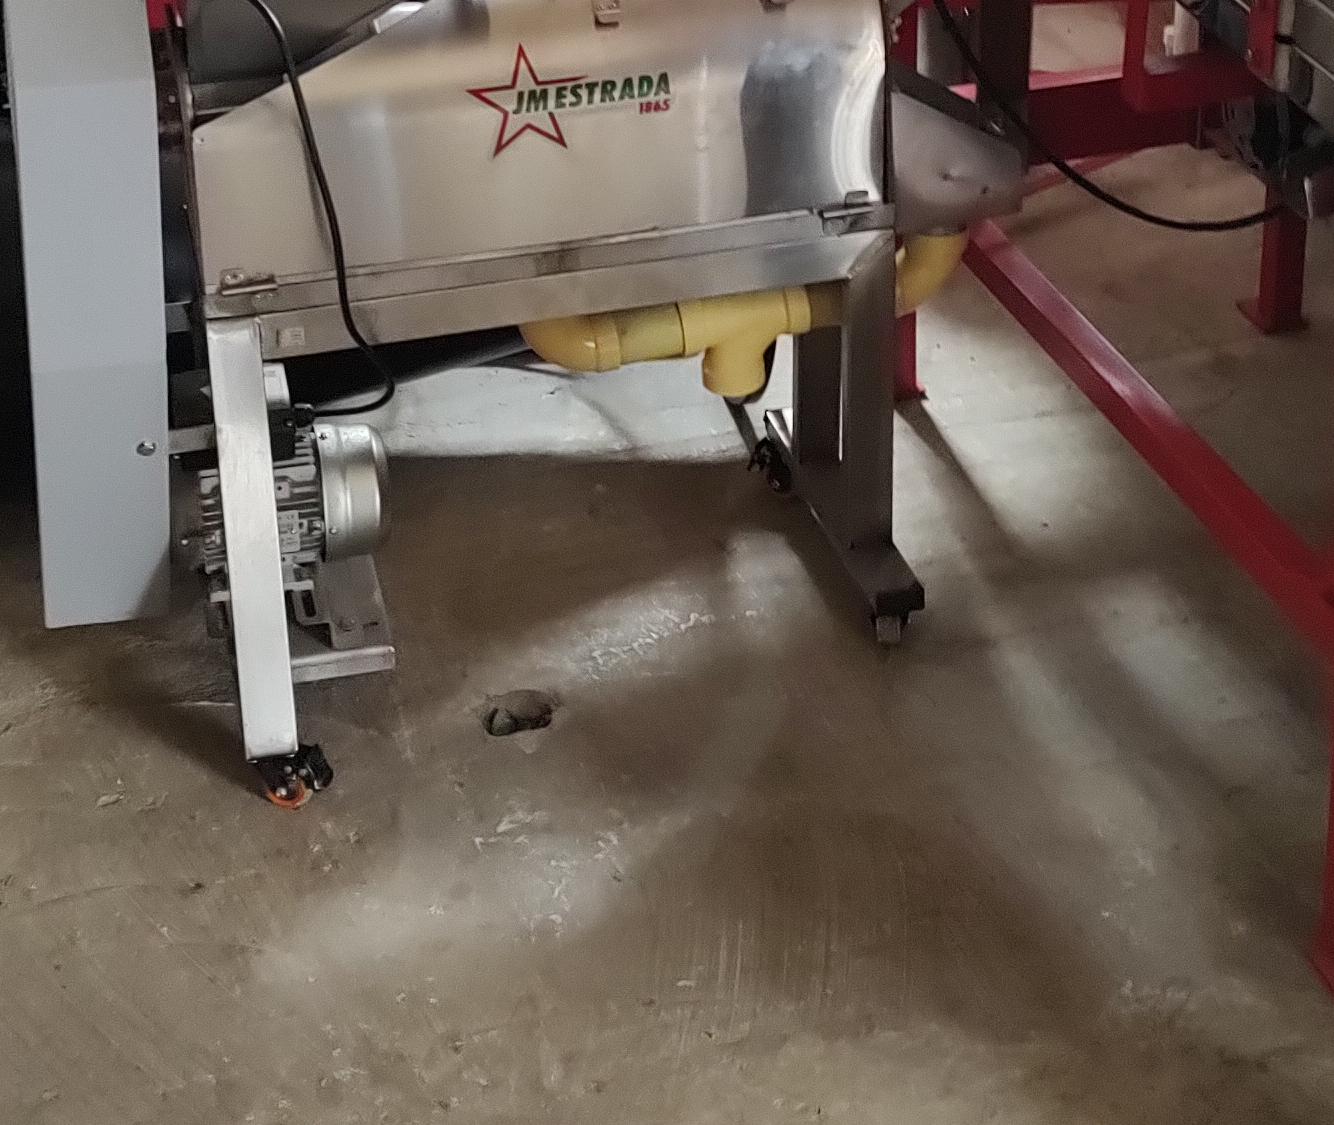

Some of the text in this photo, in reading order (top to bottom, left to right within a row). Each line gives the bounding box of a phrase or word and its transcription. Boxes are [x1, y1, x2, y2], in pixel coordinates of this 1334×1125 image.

[513, 72, 671, 115] JM ESTRADA
[639, 98, 670, 115] 1865
